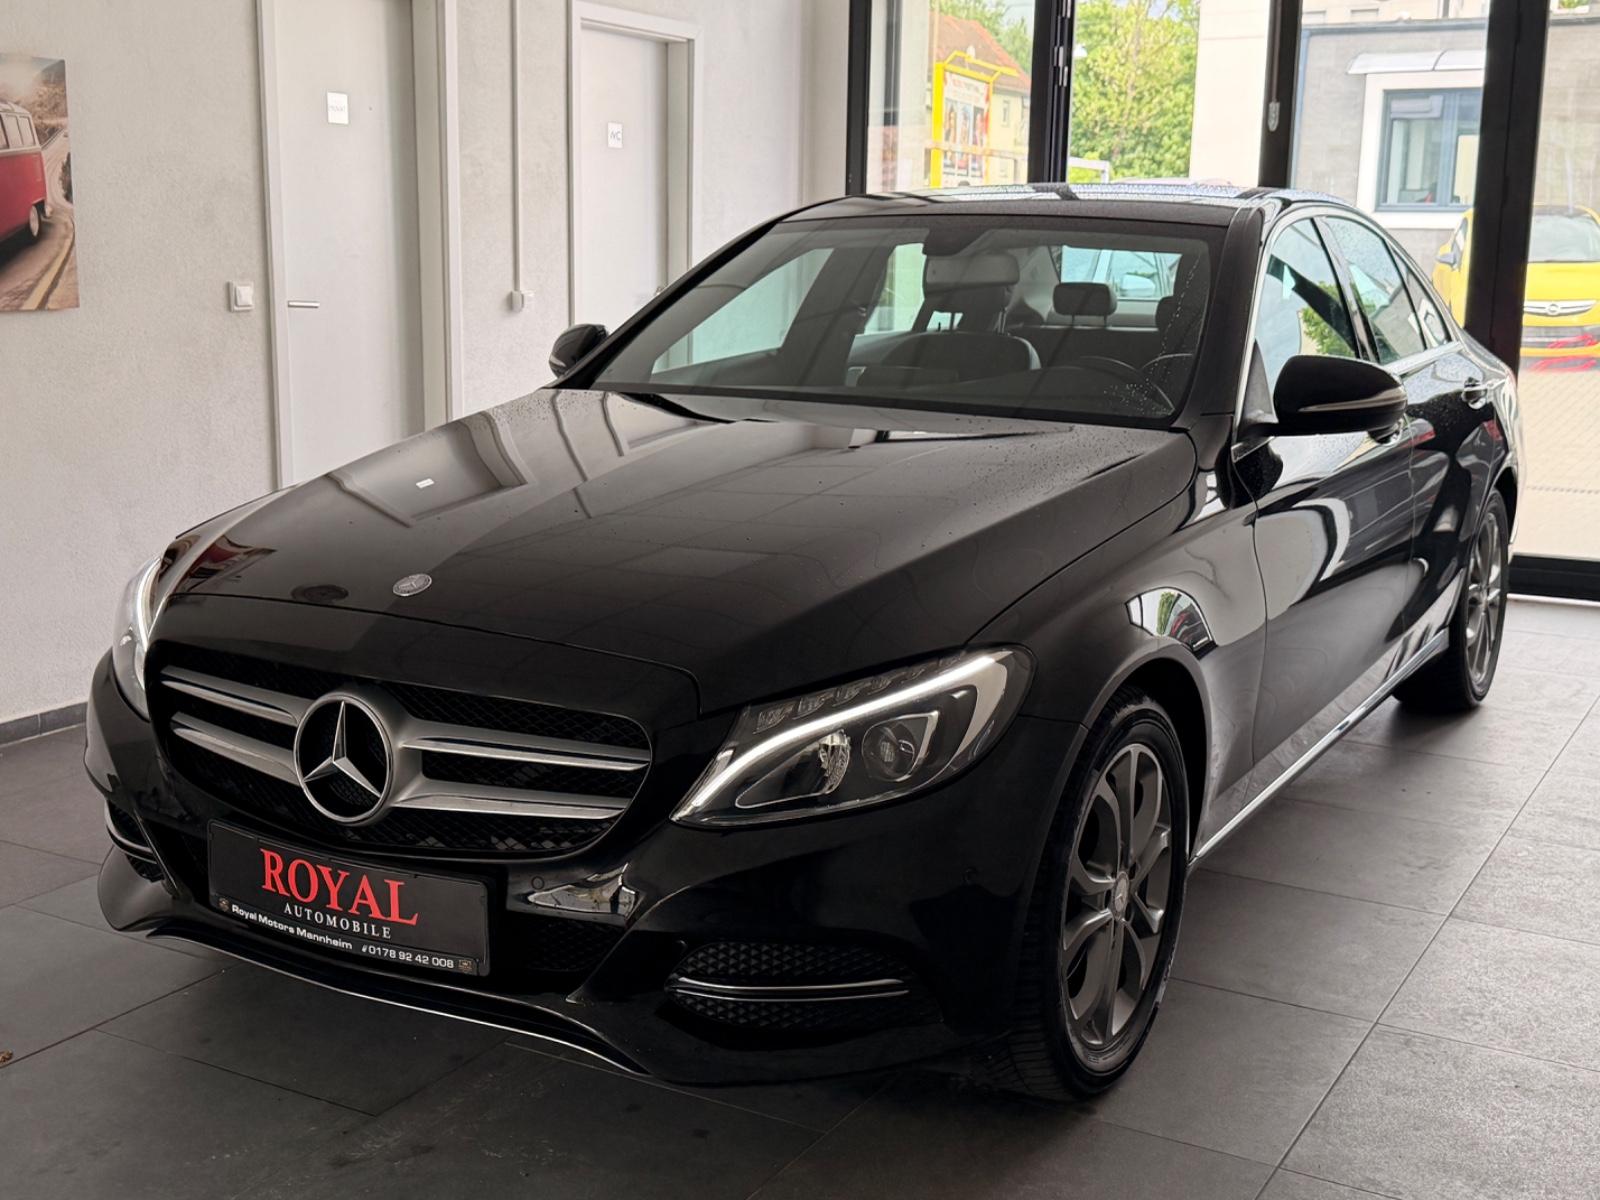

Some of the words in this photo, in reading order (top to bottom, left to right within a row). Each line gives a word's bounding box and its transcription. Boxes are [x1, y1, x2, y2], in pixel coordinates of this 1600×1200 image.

[260, 848, 419, 926] ROYAL
[231, 904, 258, 921] Royal
[258, 914, 295, 934] Motors
[296, 927, 353, 950] Mannheim
[398, 951, 412, 962] 92
[414, 954, 429, 965] 42
[431, 957, 454, 969] 008
[284, 902, 391, 939] AUTOMOBILE
